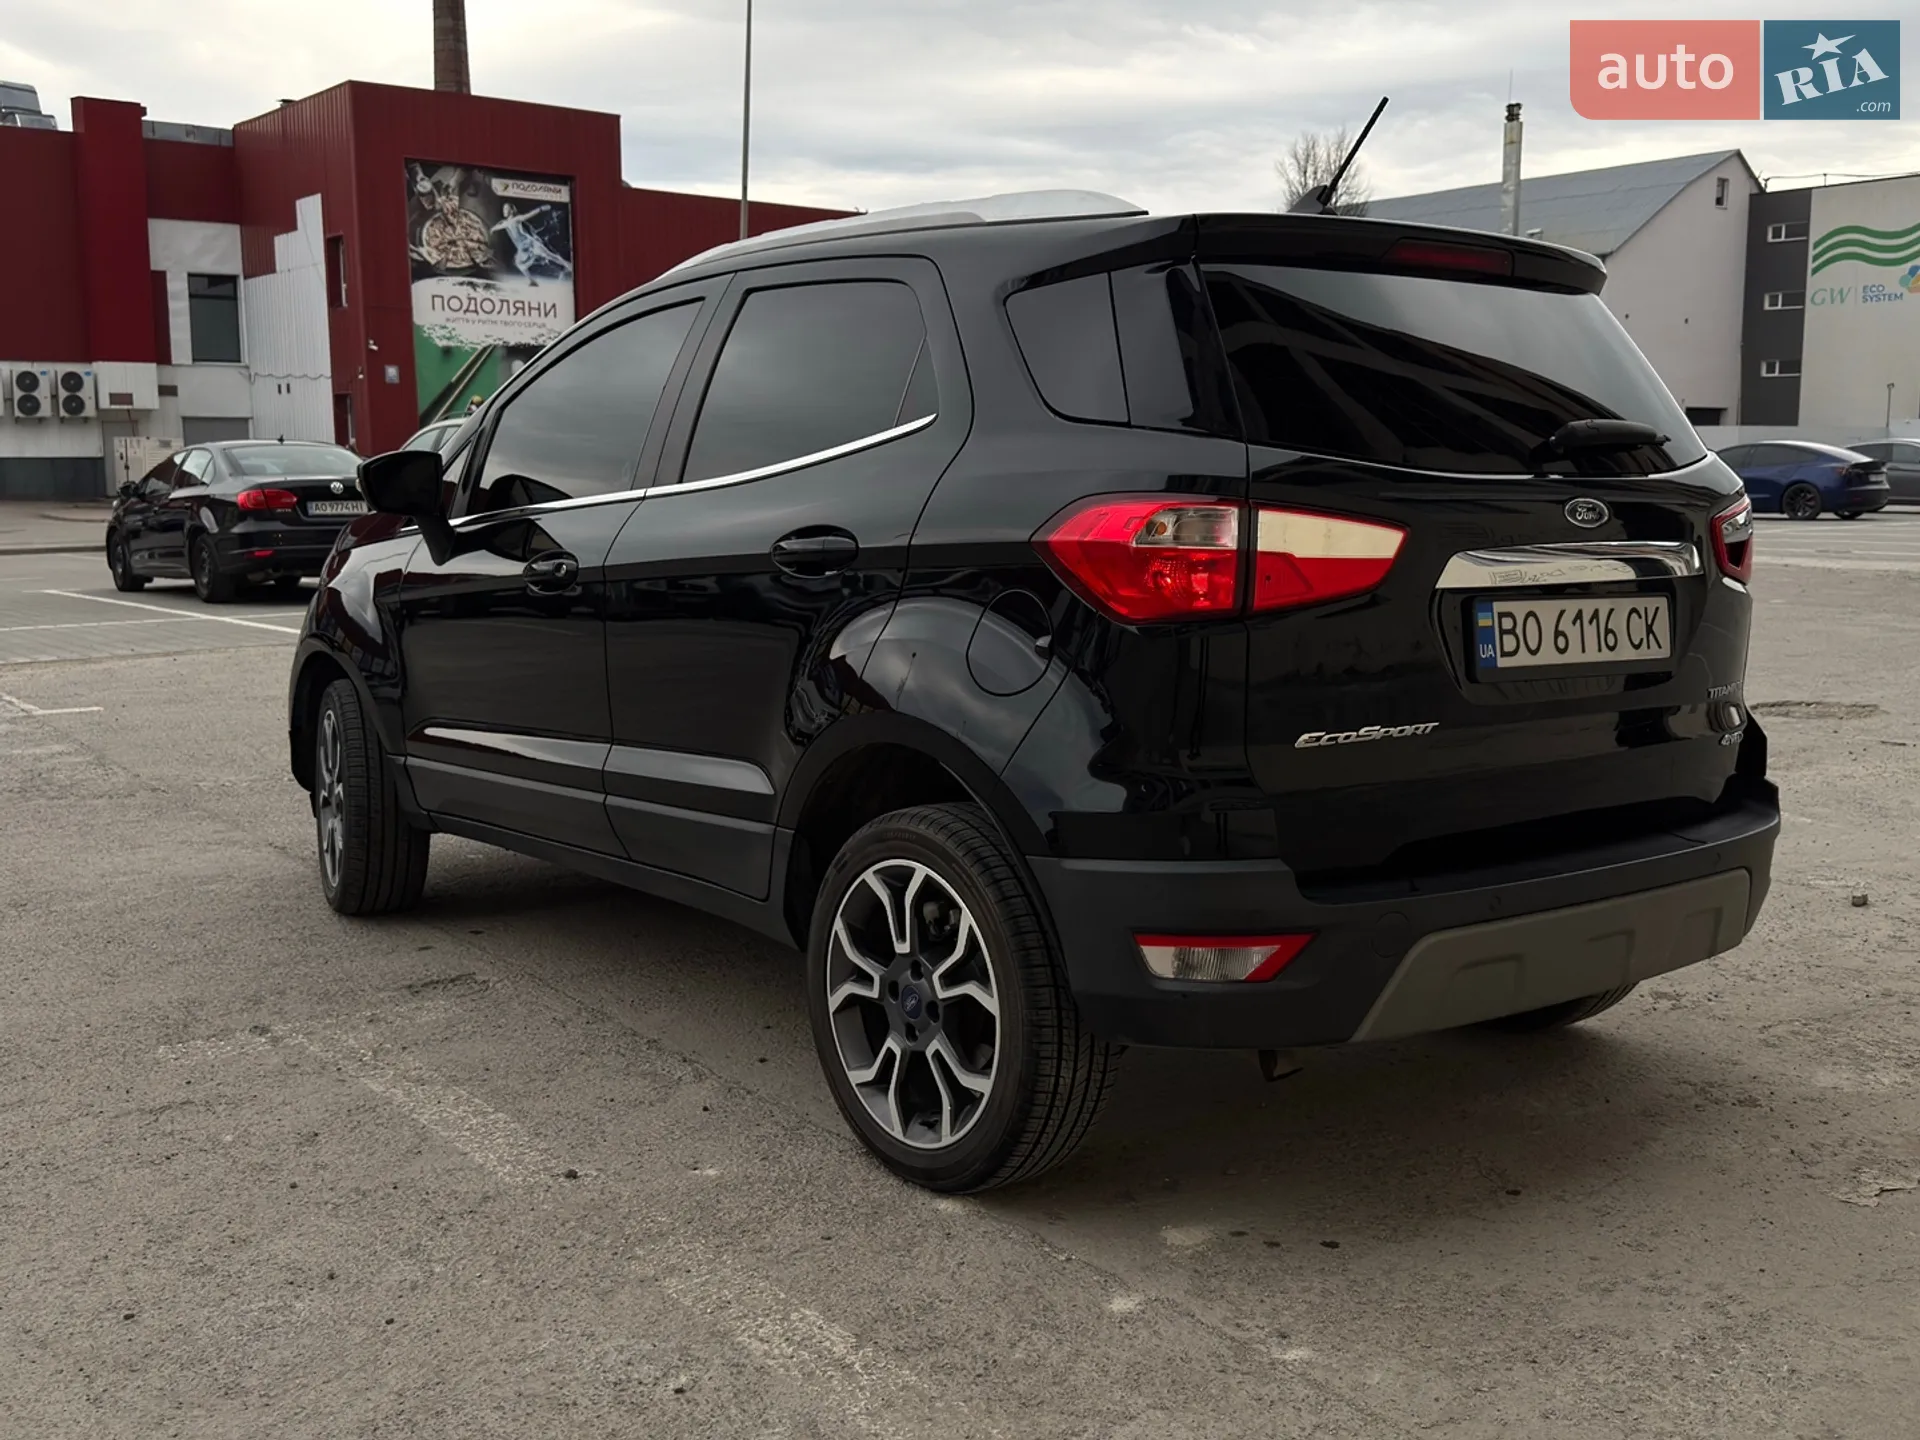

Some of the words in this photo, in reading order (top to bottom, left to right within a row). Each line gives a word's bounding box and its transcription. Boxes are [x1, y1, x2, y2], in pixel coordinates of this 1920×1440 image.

[1810, 287, 1852, 306] GW
[1862, 284, 1885, 294] ECO
[431, 294, 558, 319] ПОДОЛЯНИ
[1861, 293, 1904, 304] SYSTEM
[1497, 610, 1543, 658] BO
[1554, 607, 1618, 655] 6116
[1626, 606, 1662, 651] CK
[1479, 643, 1495, 659] UA
